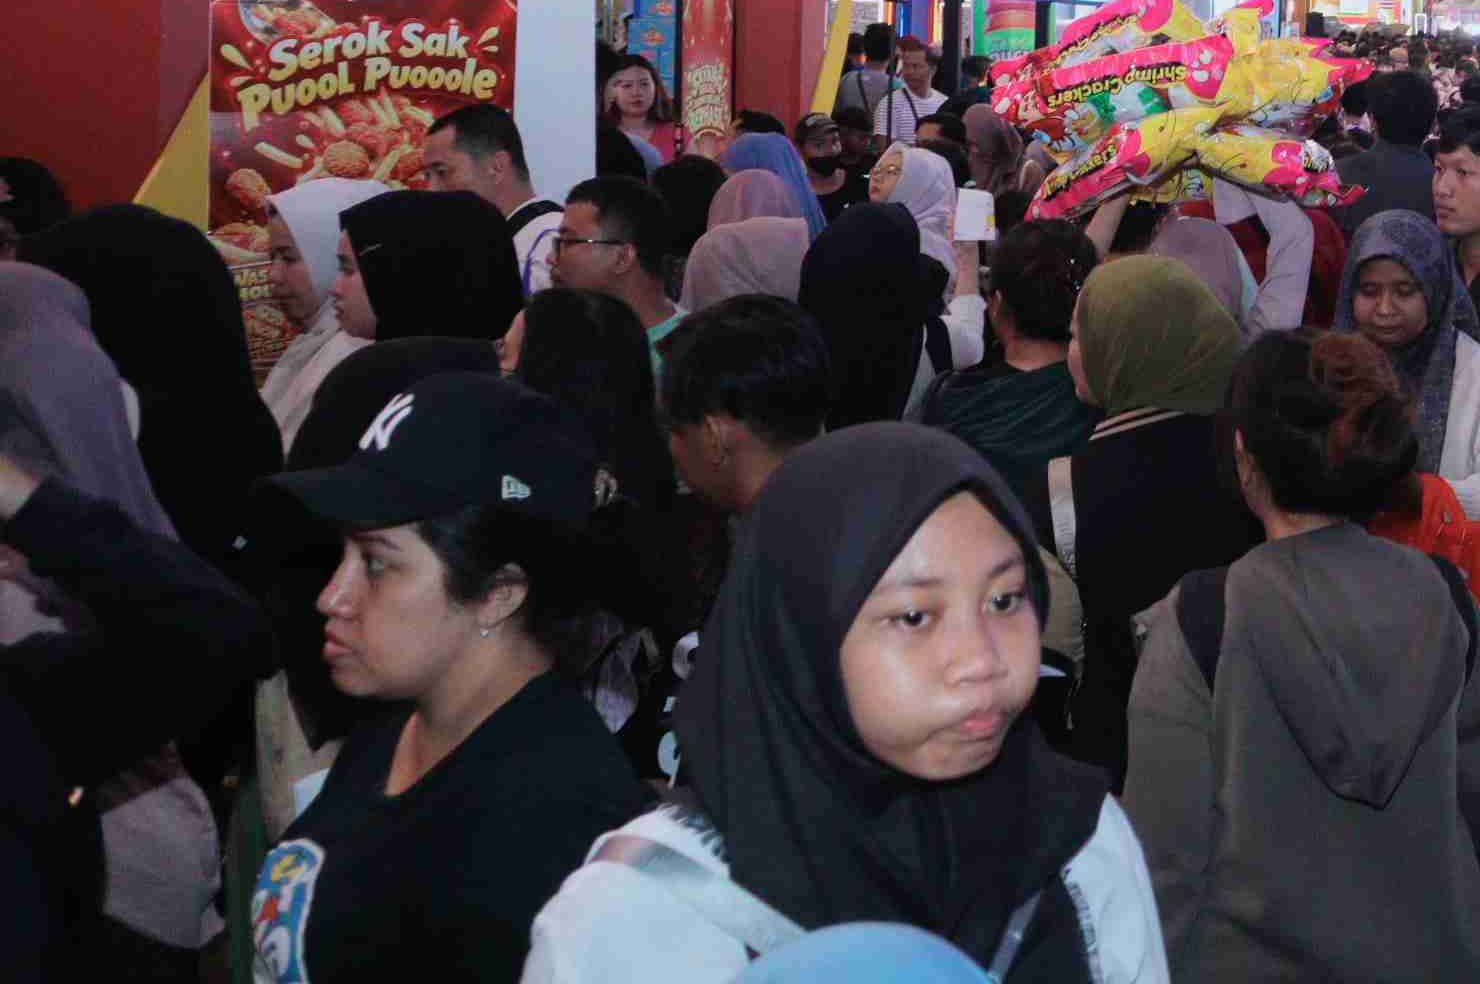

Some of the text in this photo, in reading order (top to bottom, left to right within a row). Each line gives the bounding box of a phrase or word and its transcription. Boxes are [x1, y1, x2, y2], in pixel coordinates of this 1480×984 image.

[268, 21, 470, 82] Serok Sak
[1046, 63, 1188, 108] Shrimp Crackers
